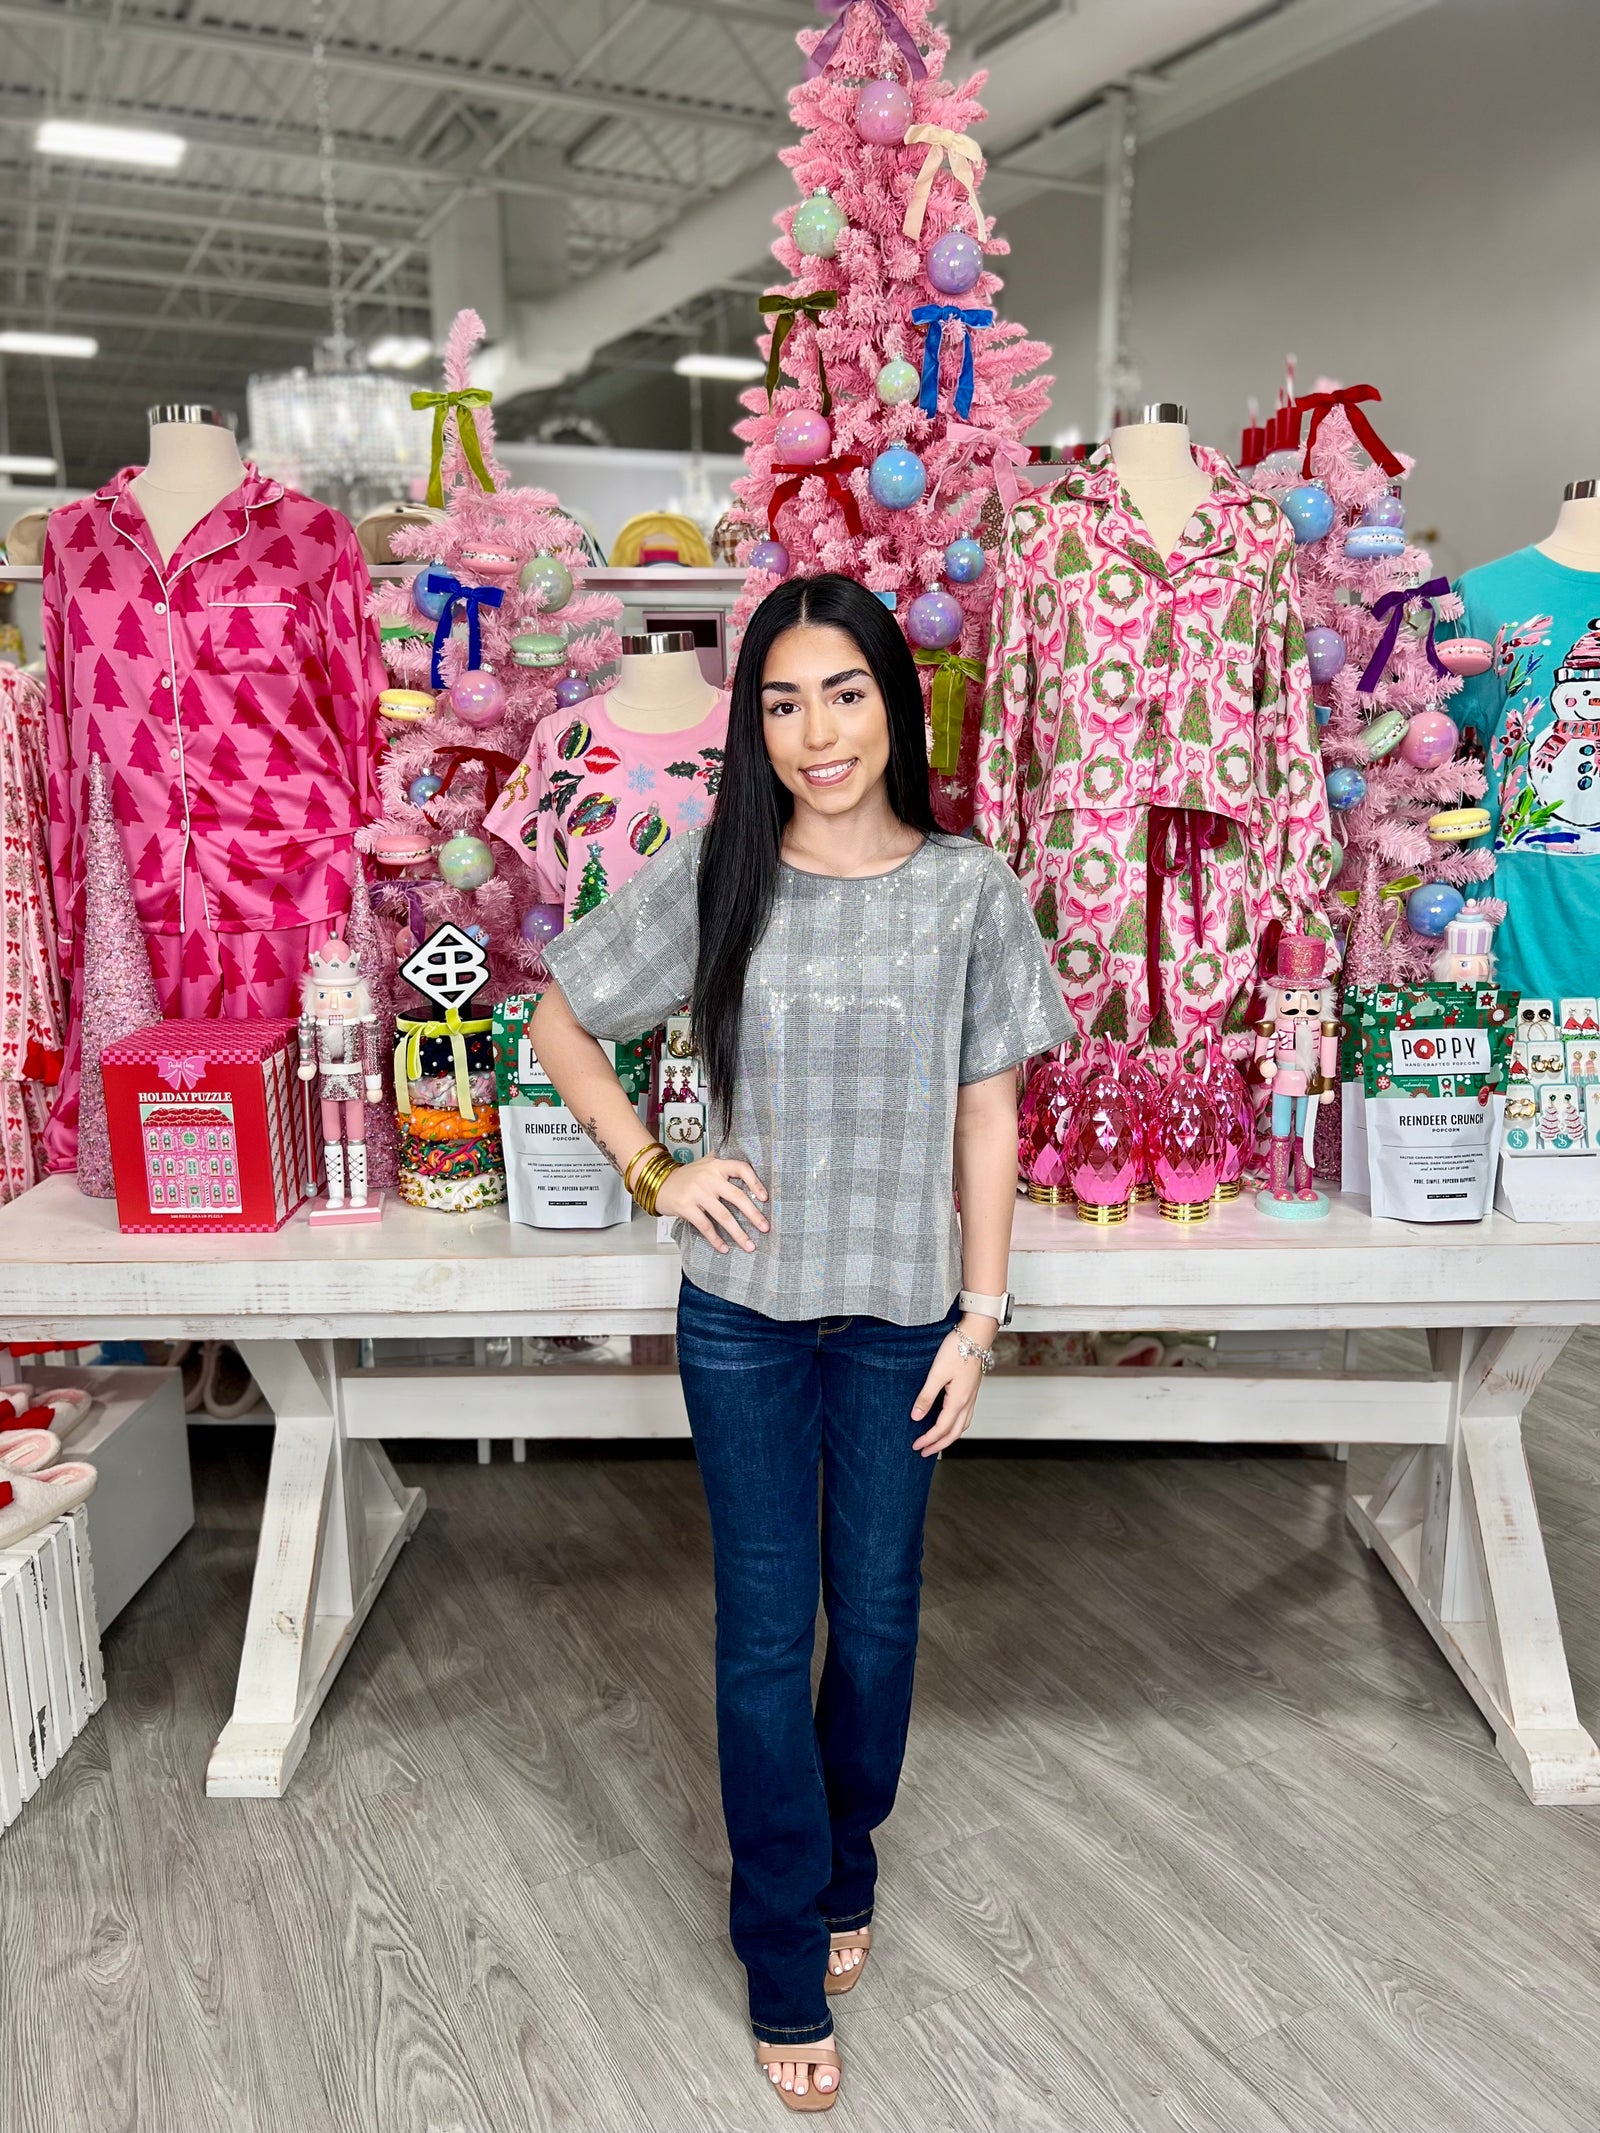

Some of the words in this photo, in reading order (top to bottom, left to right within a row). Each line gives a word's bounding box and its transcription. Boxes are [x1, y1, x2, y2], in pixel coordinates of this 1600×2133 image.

[1401, 1037, 1475, 1060] POPPY
[138, 1092, 191, 1102] HOLIDAY
[191, 1092, 232, 1102] PUZZLE
[1399, 1115, 1447, 1126] REINDEER
[1450, 1113, 1484, 1125] CRUNCH
[525, 1123, 567, 1134] REINDEER
